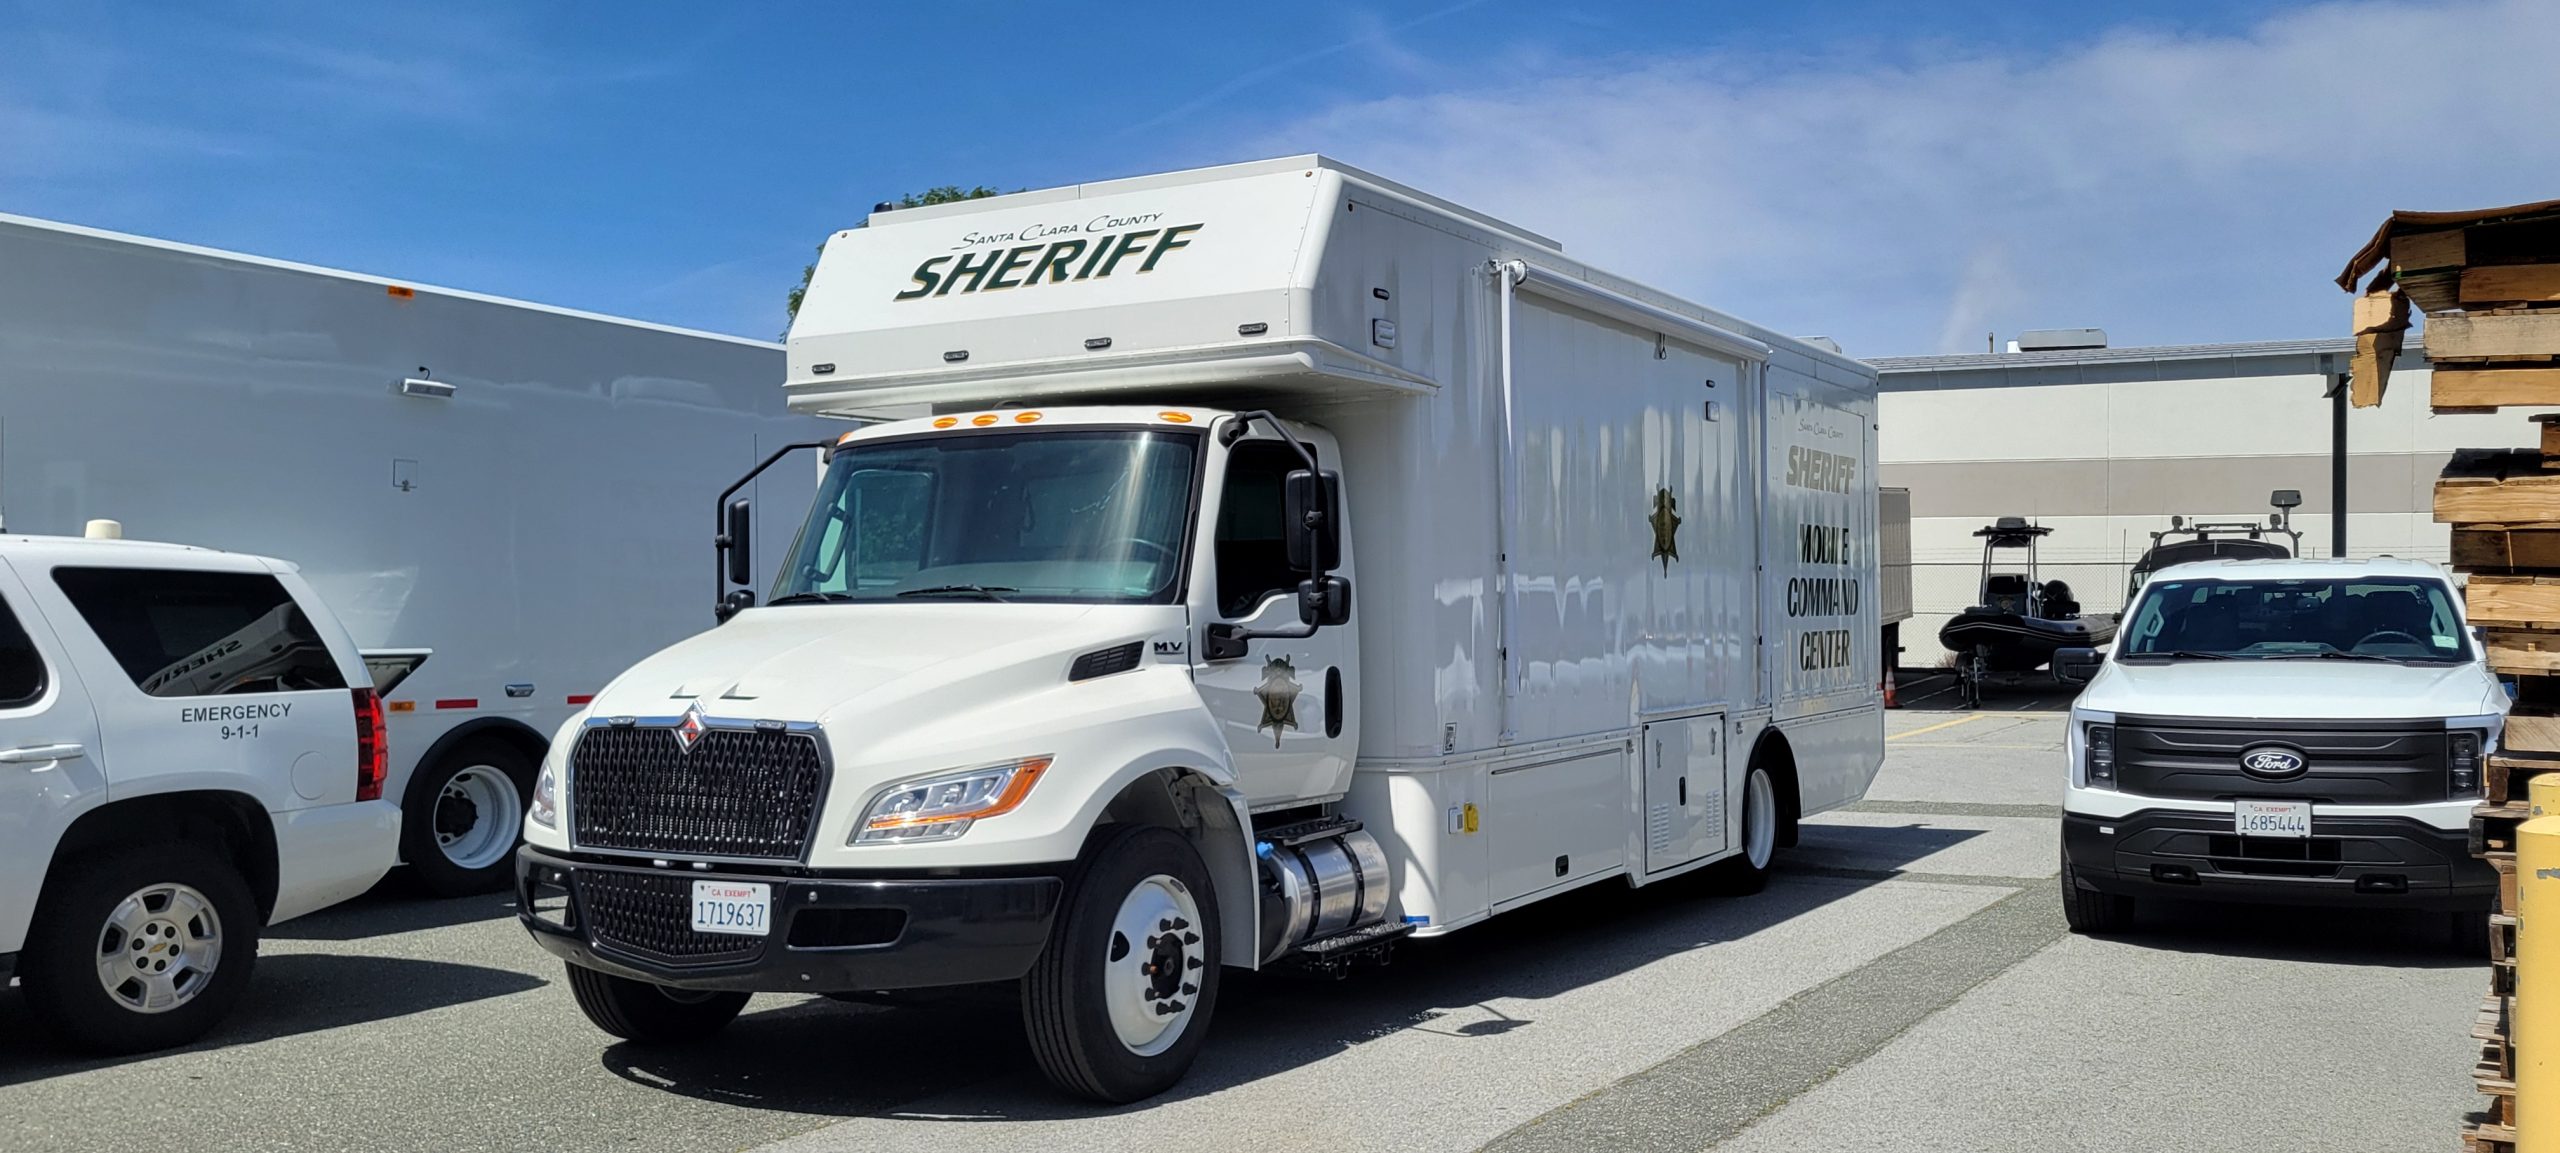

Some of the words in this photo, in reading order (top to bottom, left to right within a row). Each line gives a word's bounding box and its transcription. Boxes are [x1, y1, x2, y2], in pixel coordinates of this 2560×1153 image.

[893, 222, 1204, 302] SHERIFF
[1786, 445, 1857, 495] SHERIFF
[1798, 523, 1849, 565] MOBILE
[1787, 577, 1859, 617] COMMAND
[1154, 641, 1183, 651] MV
[1800, 629, 1850, 672] CENTER
[181, 703, 292, 723] EMERGENCY
[221, 724, 259, 740] 9-1-1
[2254, 754, 2292, 769] Ford
[2241, 814, 2305, 831] 1685444
[724, 889, 751, 898] EXEMPT
[697, 901, 764, 927] 1719637
